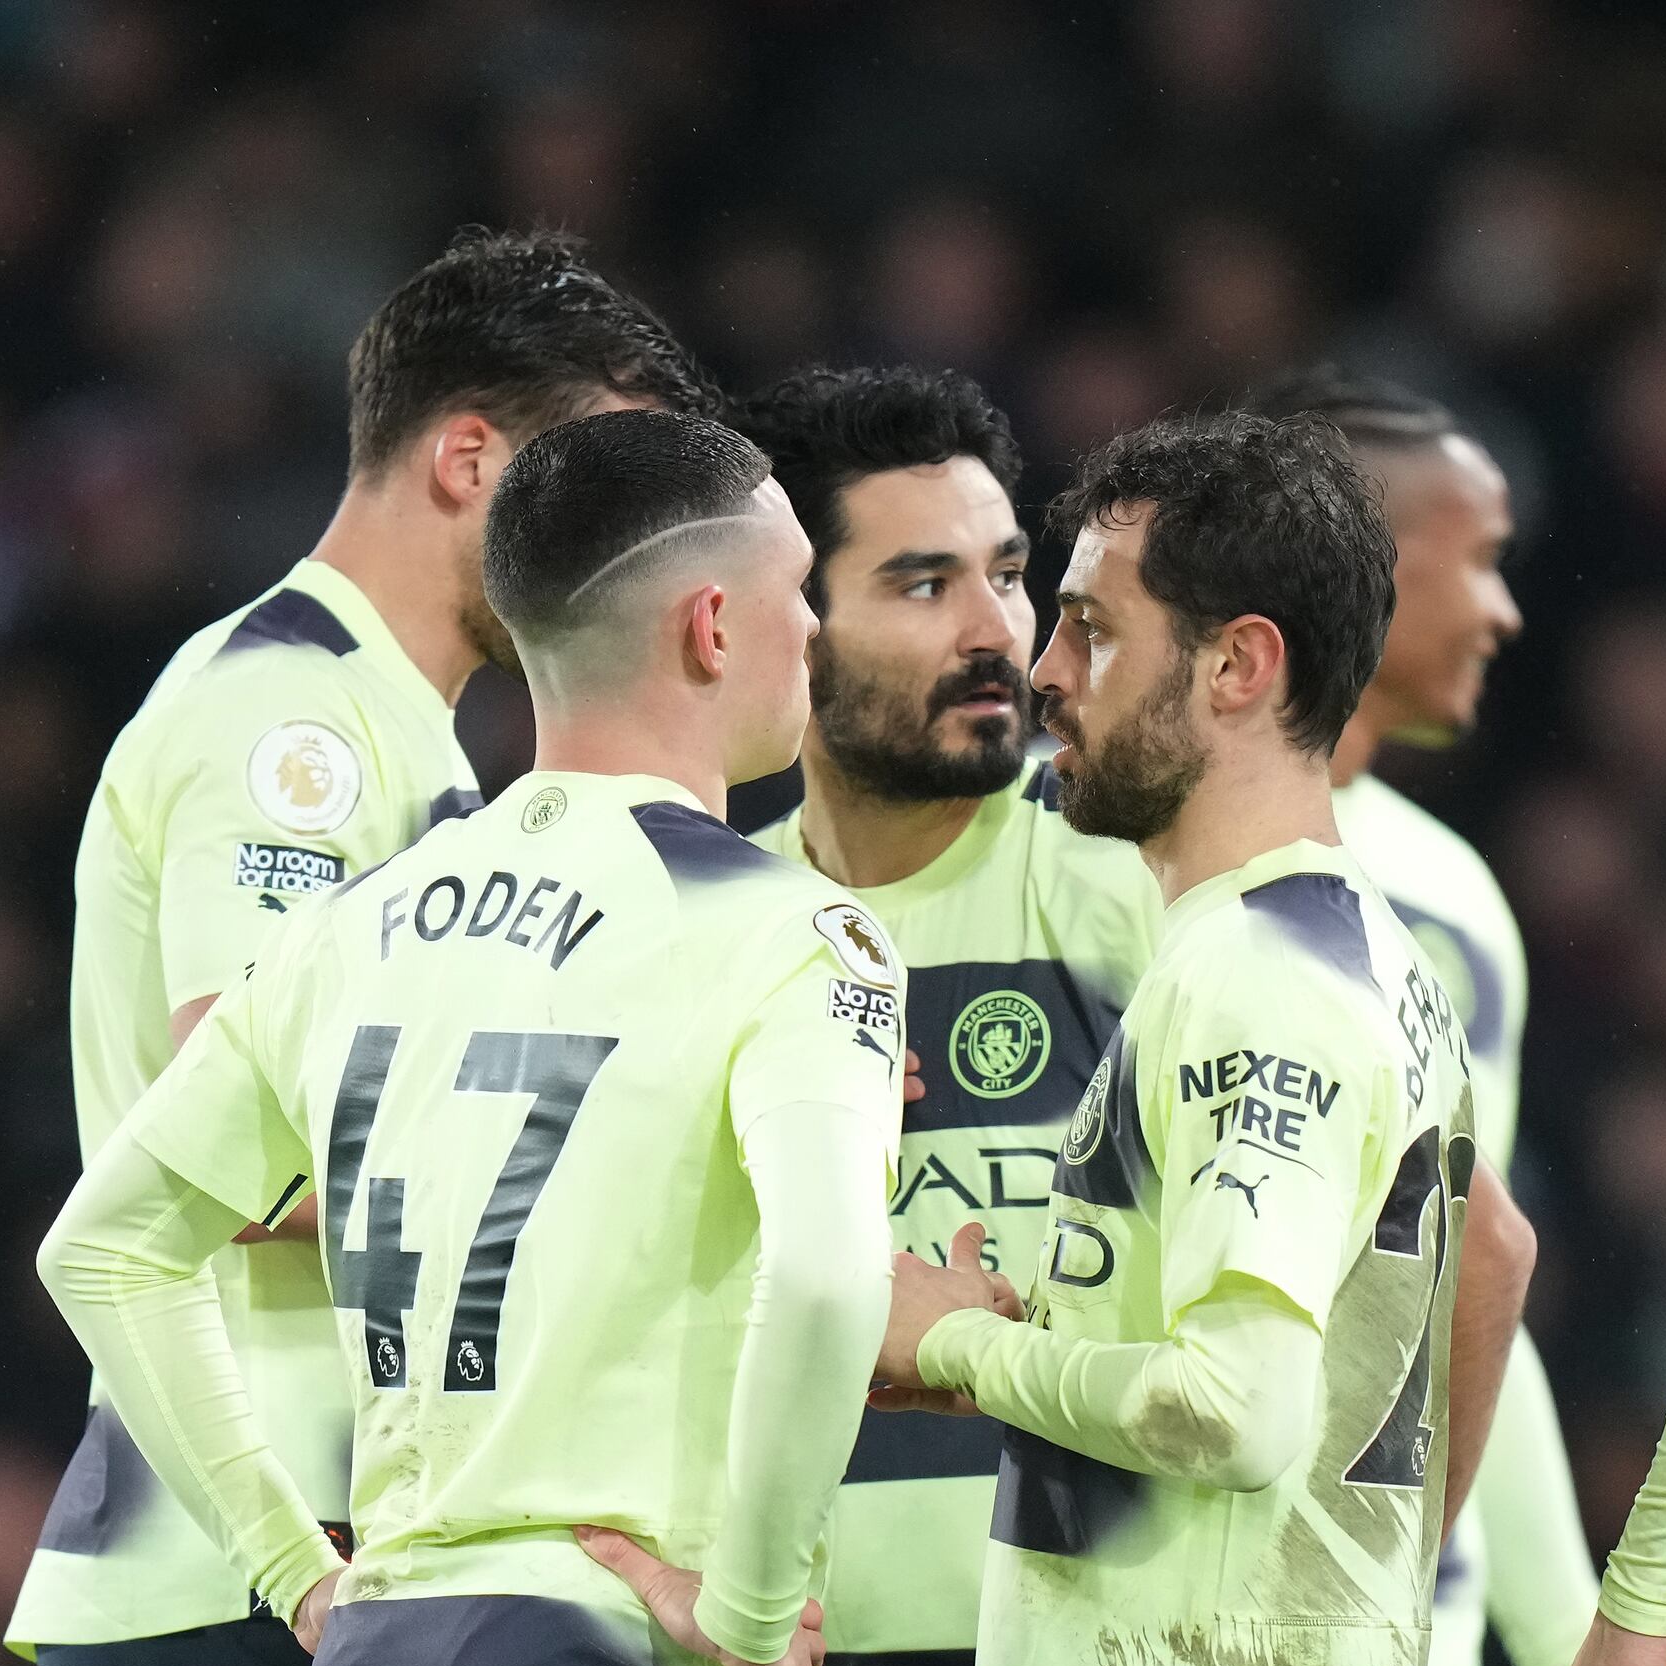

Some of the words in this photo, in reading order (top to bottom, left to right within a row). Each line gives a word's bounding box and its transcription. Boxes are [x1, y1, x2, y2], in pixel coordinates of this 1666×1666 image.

[236, 844, 274, 869] No
[275, 850, 337, 879] room
[380, 871, 604, 971] FODEN
[829, 978, 868, 1008] No
[962, 997, 1041, 1033] MANCHESTER
[982, 1077, 1013, 1090] CITY
[1178, 1048, 1342, 1121] NEXEN
[1209, 1105, 1307, 1152] TIRE
[325, 1025, 620, 1393] 47
